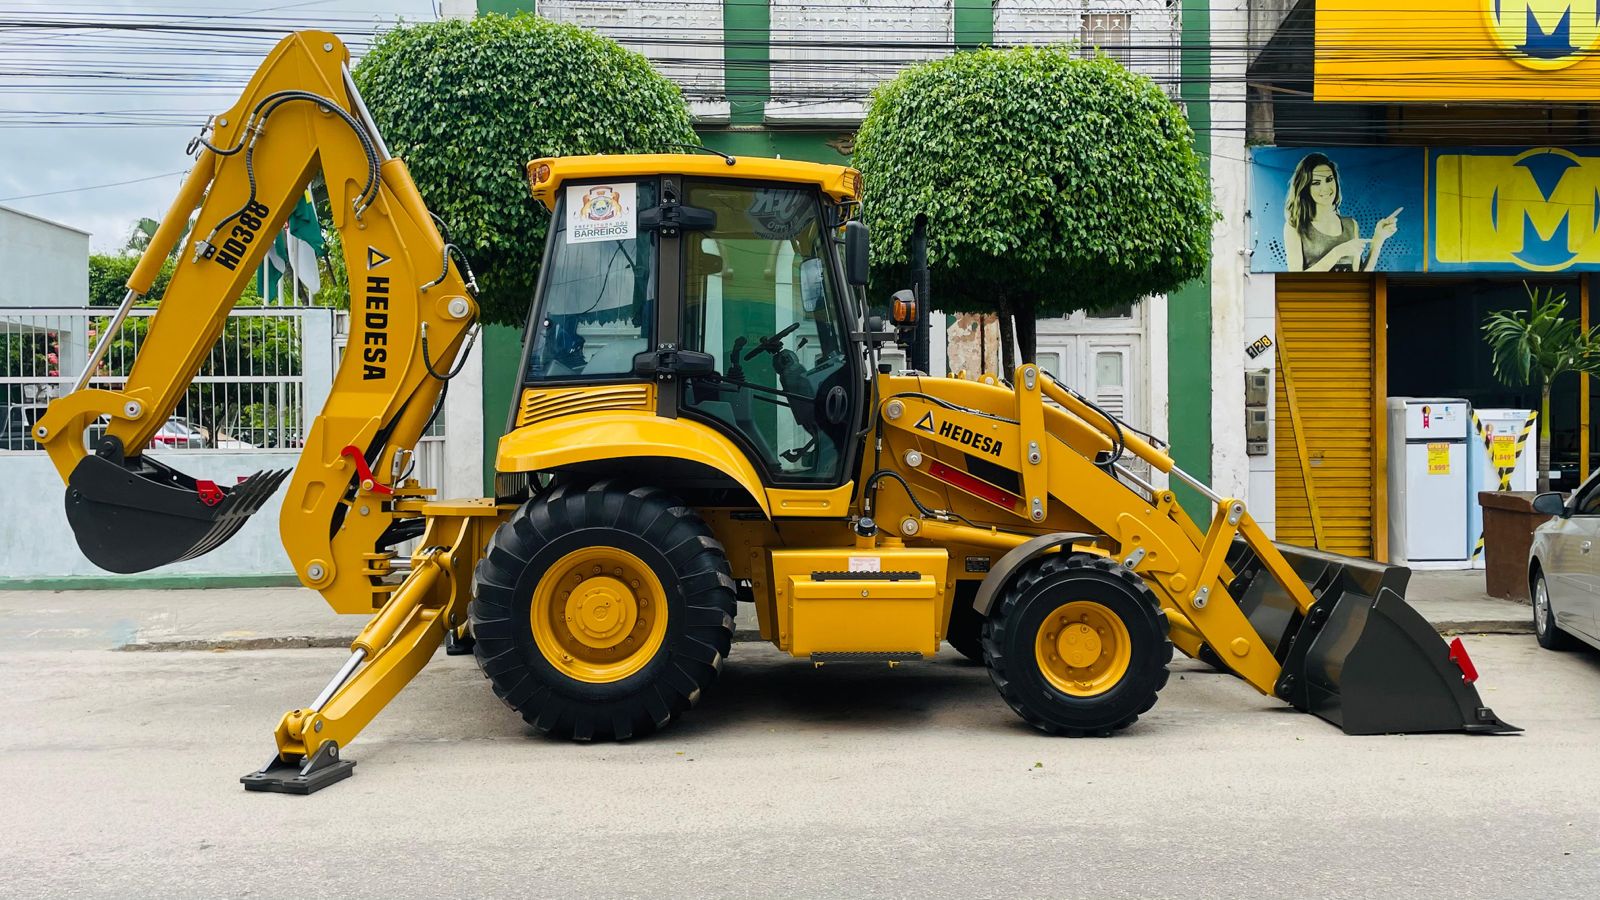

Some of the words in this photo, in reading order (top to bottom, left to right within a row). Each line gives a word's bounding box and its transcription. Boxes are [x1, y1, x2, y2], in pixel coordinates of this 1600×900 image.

[215, 200, 270, 271] HD388
[574, 226, 629, 238] BARREIROS
[363, 276, 390, 381] HEDESA
[1247, 336, 1272, 358] 128
[939, 420, 1003, 457] HEDESA
